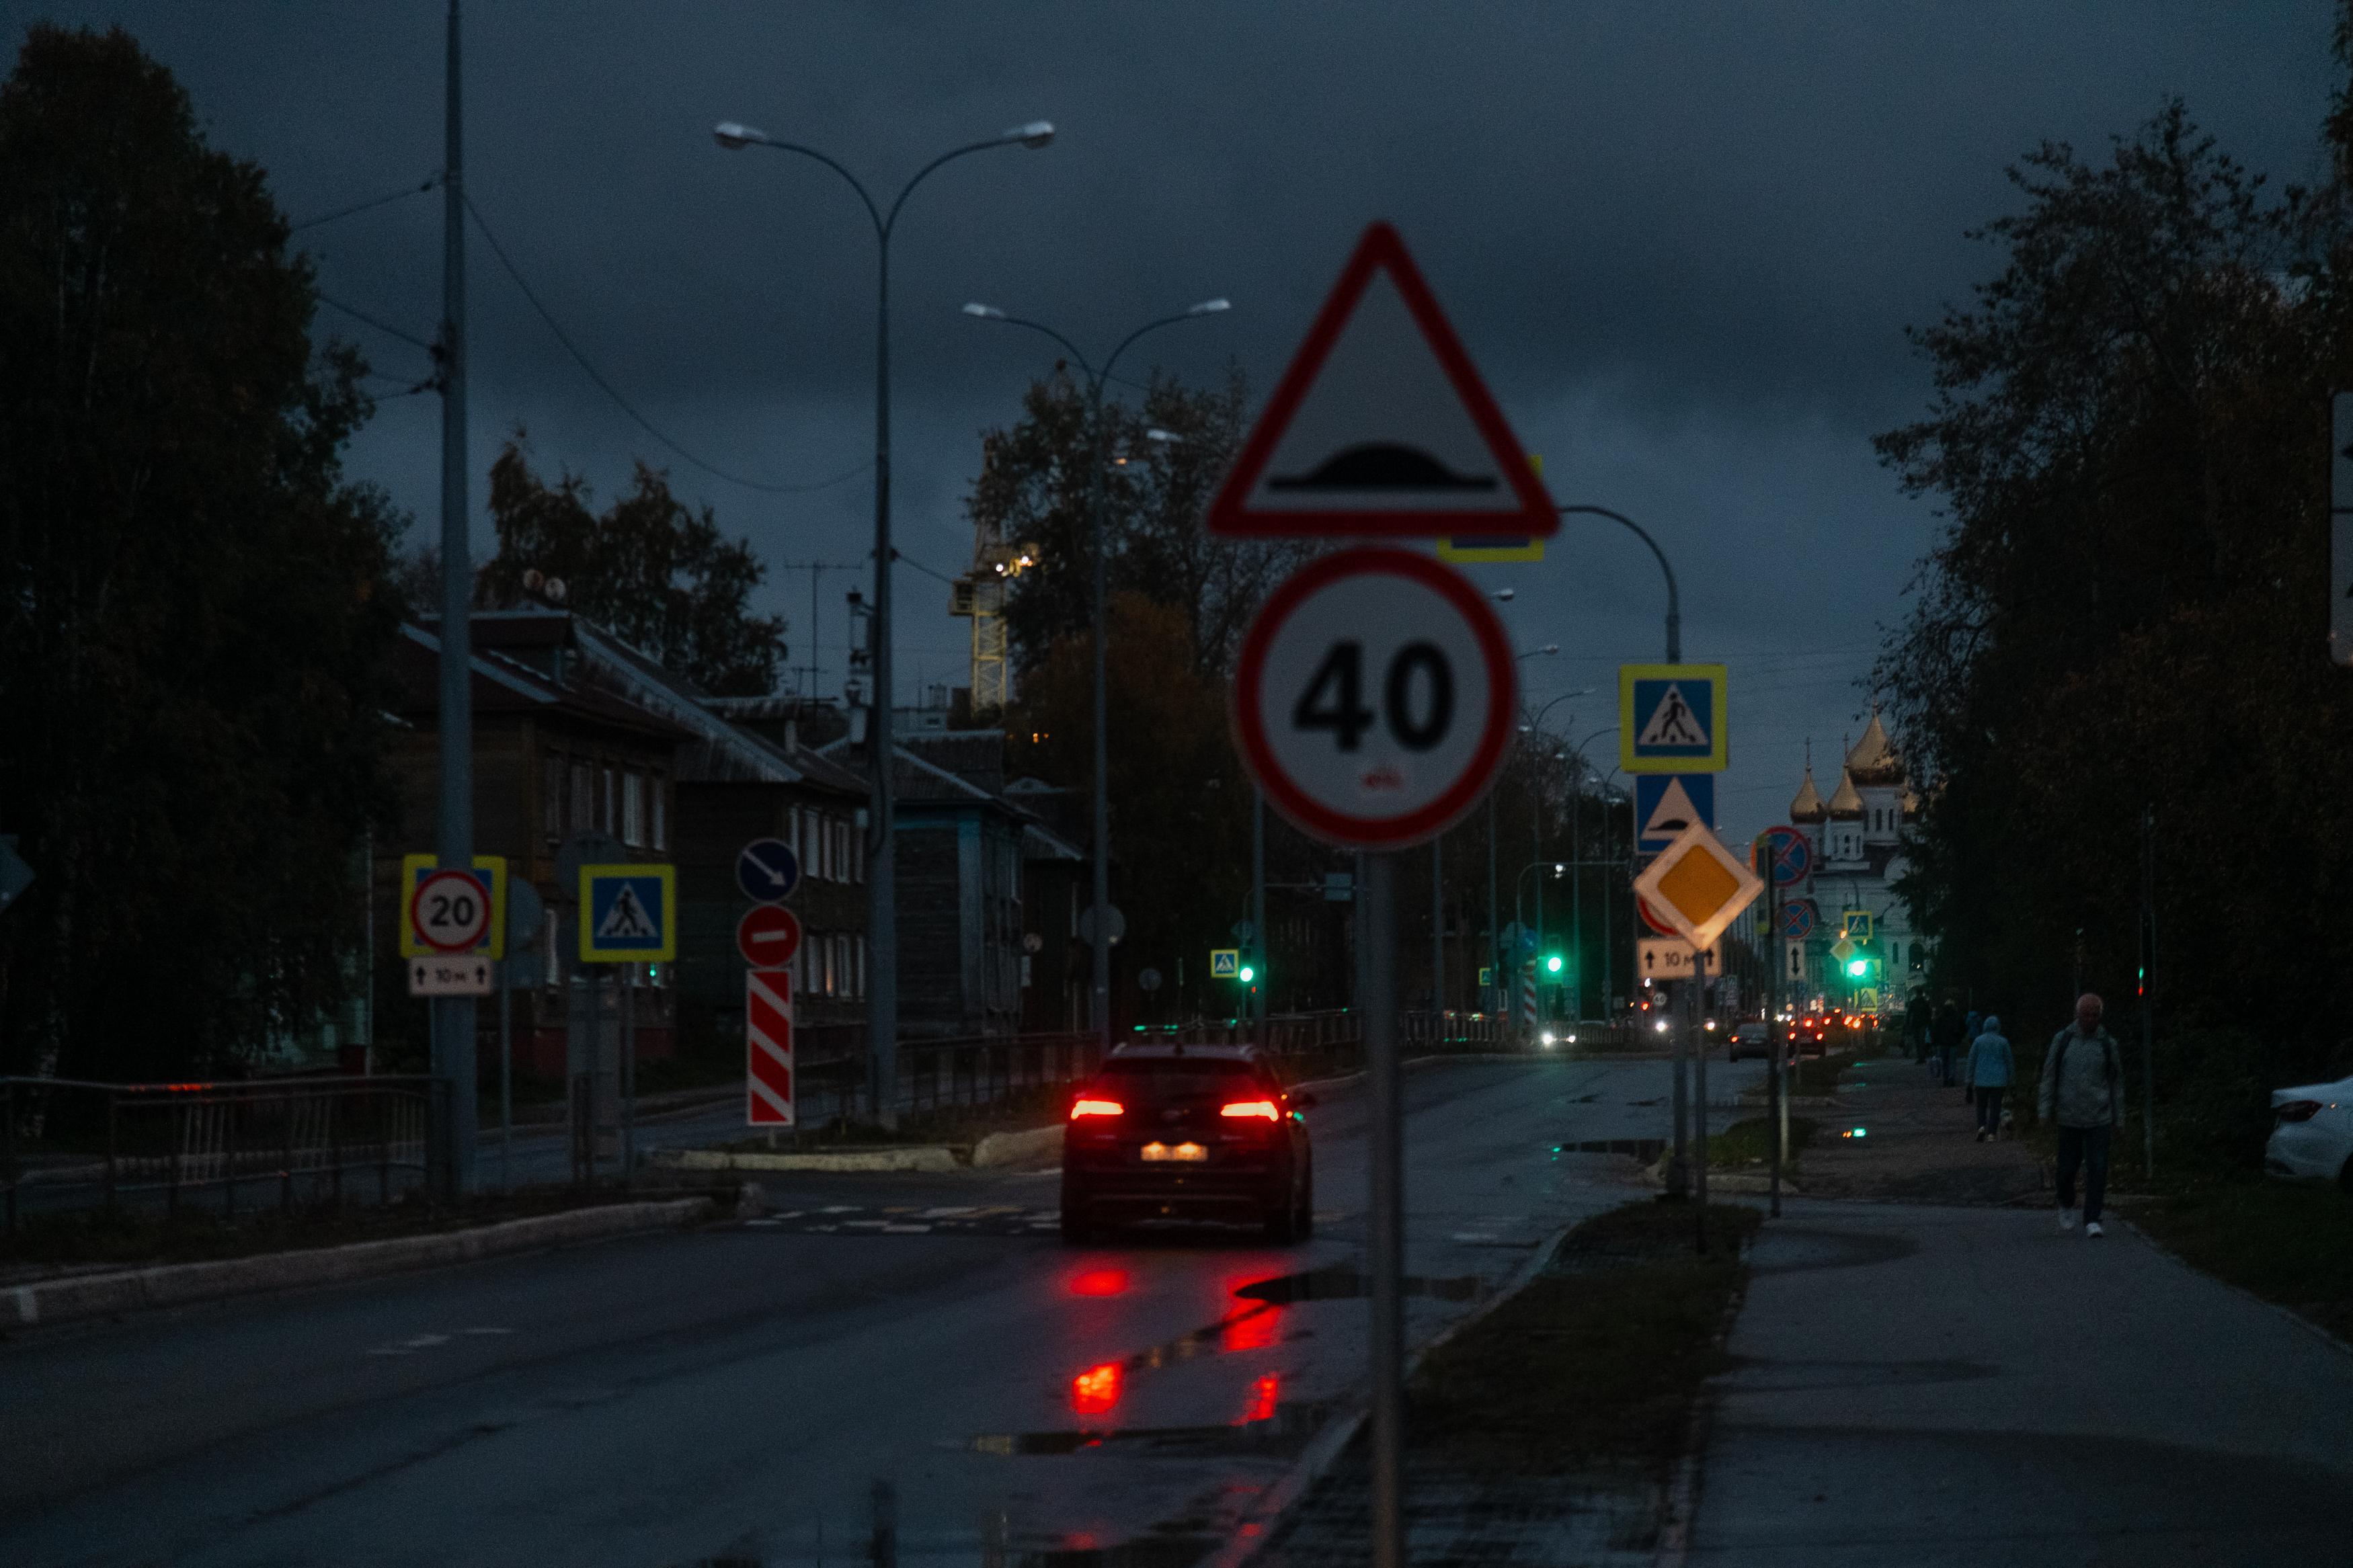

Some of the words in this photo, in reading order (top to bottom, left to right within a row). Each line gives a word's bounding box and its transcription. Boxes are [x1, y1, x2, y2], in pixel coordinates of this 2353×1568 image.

[1295, 642, 1453, 751] 40
[430, 895, 474, 926] 20
[1665, 952, 1680, 966] 10
